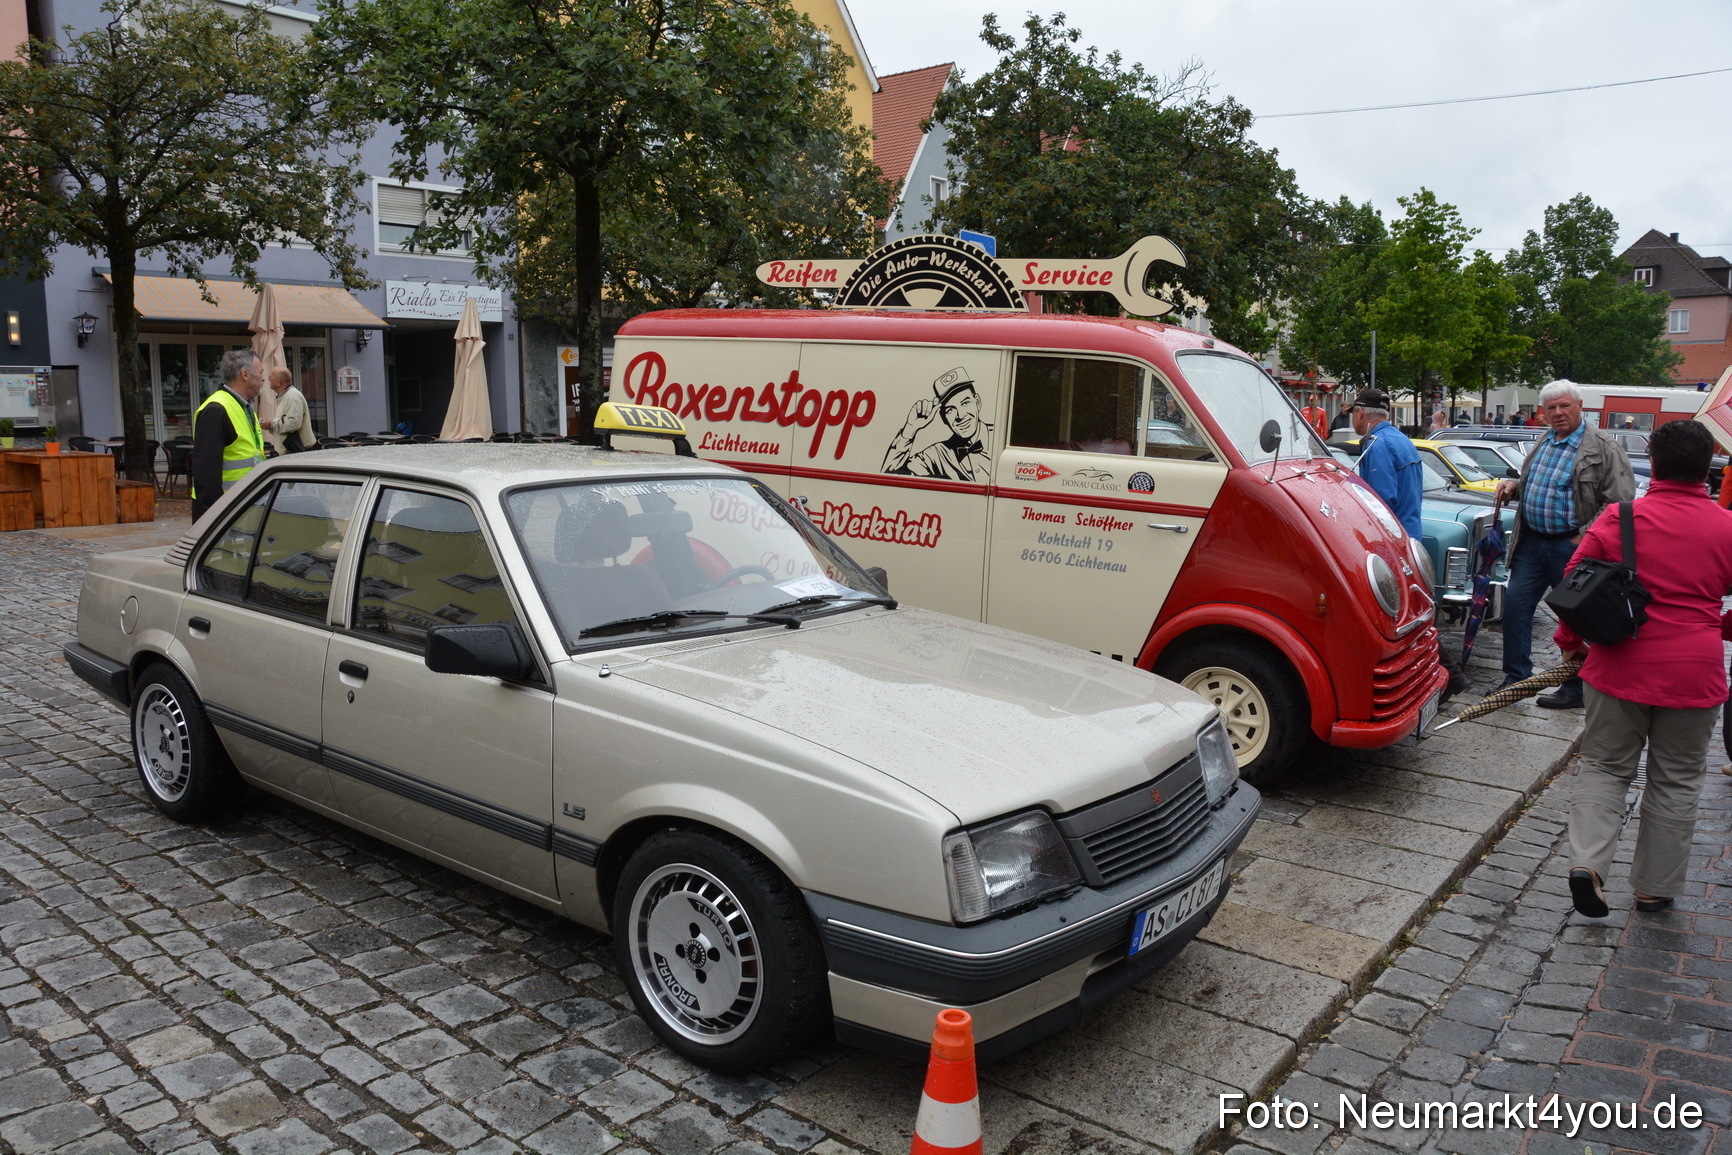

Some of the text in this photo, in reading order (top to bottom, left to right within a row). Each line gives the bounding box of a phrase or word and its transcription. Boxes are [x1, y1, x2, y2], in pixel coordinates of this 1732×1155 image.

[767, 261, 838, 287] Reifen
[858, 250, 998, 298] Die Auto-Werkstatt
[1022, 261, 1113, 286] Service
[391, 287, 437, 307] Rialto
[440, 289, 456, 303] Eis
[620, 407, 679, 429] TAXI
[623, 351, 876, 460] Boxenstopp
[698, 431, 780, 456] Lichtenau
[1062, 478, 1121, 492] DONAU CLASSIC
[710, 491, 749, 525] Die
[1021, 506, 1134, 532] Thomas Schöffner
[1038, 531, 1114, 552] Kohlstatt 19
[1021, 549, 1127, 573] 86706 Lichtenau
[562, 801, 586, 821] LS
[1141, 869, 1216, 946] AS CI 87
[695, 901, 733, 948] TURBO
